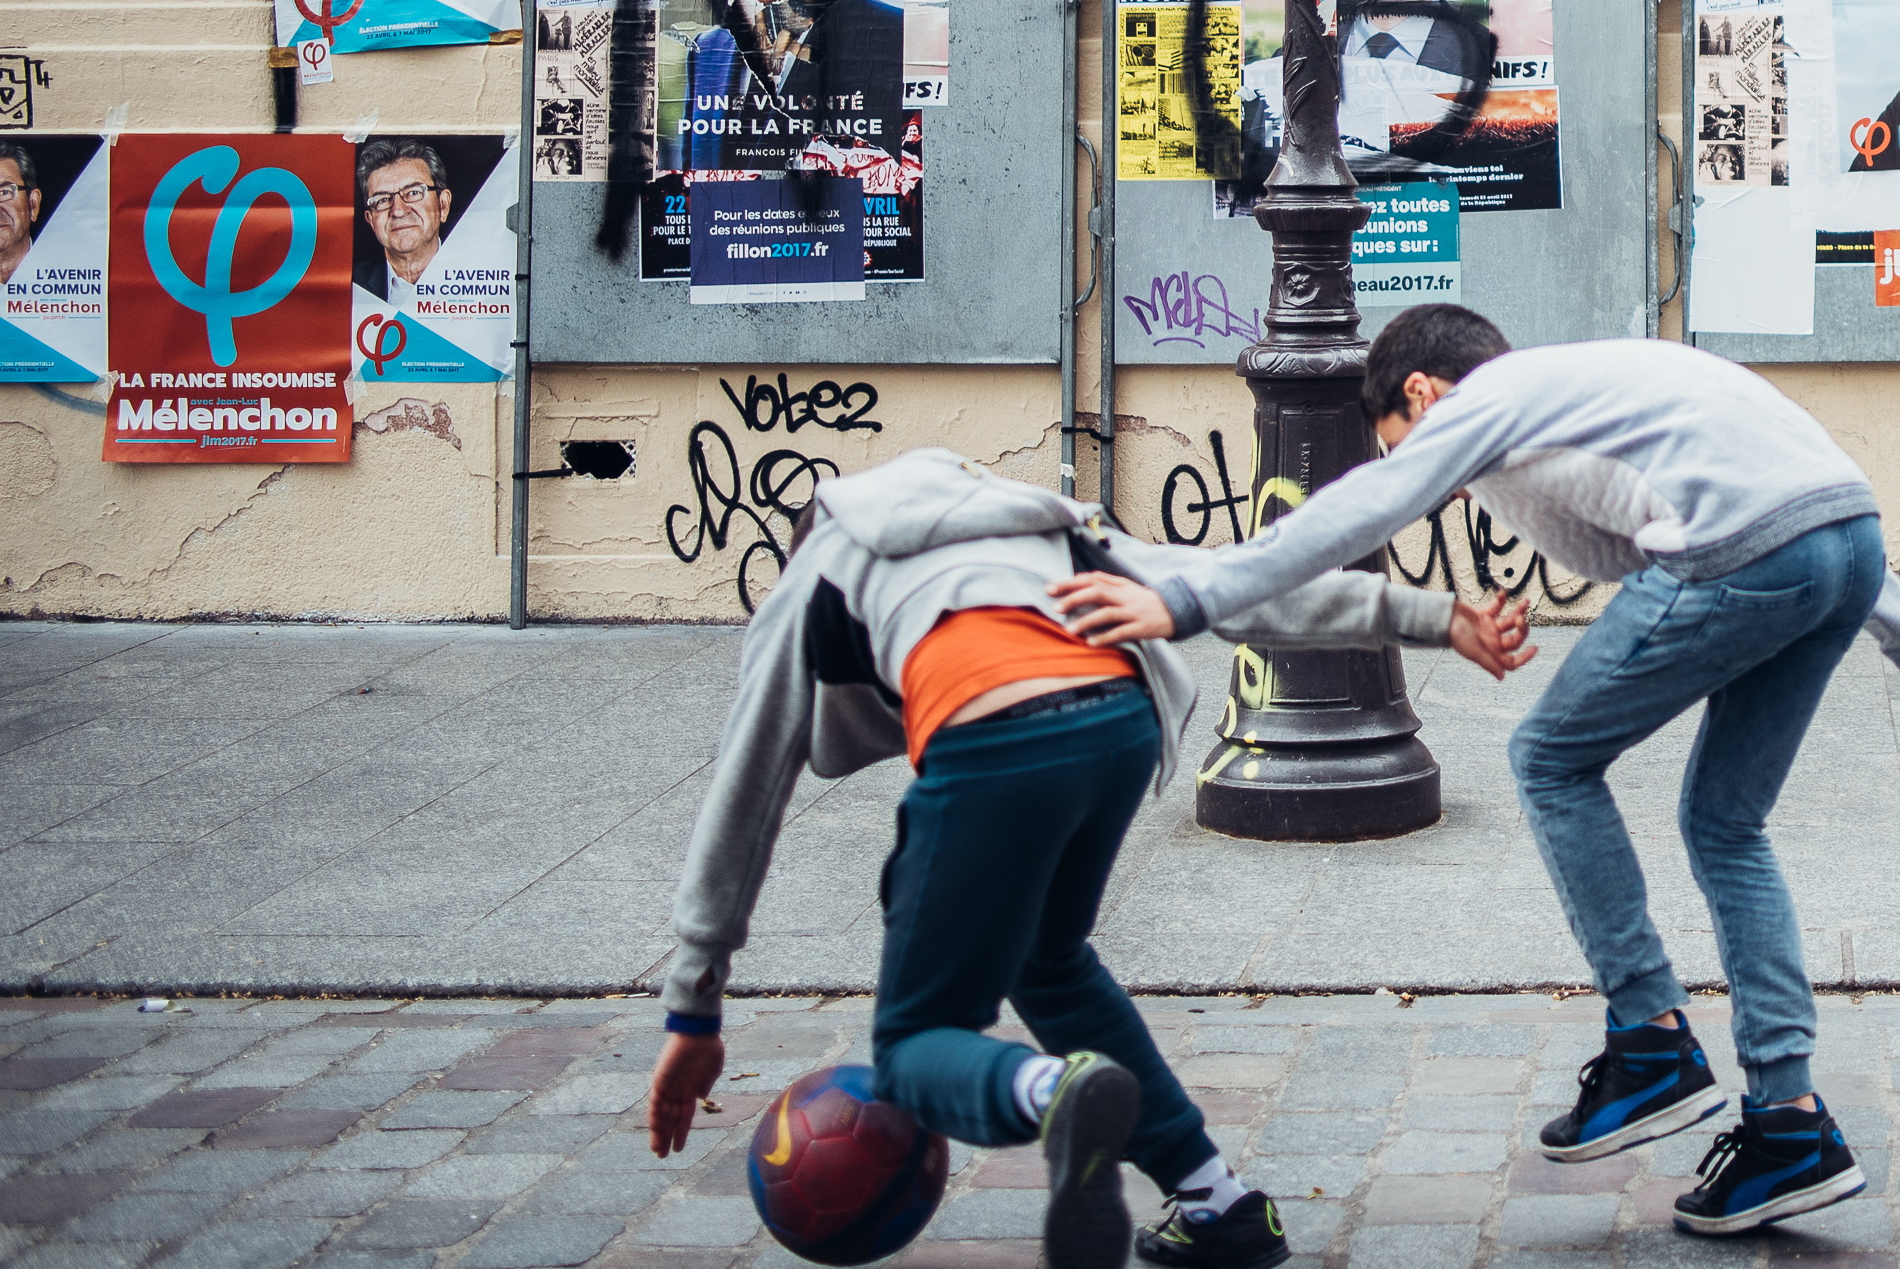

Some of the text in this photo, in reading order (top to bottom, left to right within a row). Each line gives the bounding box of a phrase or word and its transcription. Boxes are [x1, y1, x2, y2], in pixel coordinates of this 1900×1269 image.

[678, 118, 883, 135] POUR LA FRANCE
[736, 148, 786, 158] FRANÇOIS
[1489, 173, 1524, 181] dernier
[665, 195, 686, 214] 22
[1391, 197, 1450, 214] toutes
[665, 215, 686, 225] TOUS
[714, 209, 796, 222] Pour les dates
[872, 217, 899, 227] LA RUE
[653, 225, 686, 236] POUR LE
[709, 222, 846, 236] des réunions publiques
[884, 226, 912, 237] SOCIAL
[726, 242, 829, 259] fillon2017.fr
[36, 269, 101, 280] L'AVENIR
[444, 270, 510, 281] L'AVENIR
[7, 284, 101, 295] EN COMMUN
[417, 285, 510, 295] EN COMMUN
[7, 300, 101, 313] Mélenchon
[417, 301, 510, 314] Mélenchon
[119, 372, 336, 388] LA FRANCE INSOUMISE
[118, 397, 338, 431] Mélenchon
[201, 435, 258, 448] jlm2017.fr
